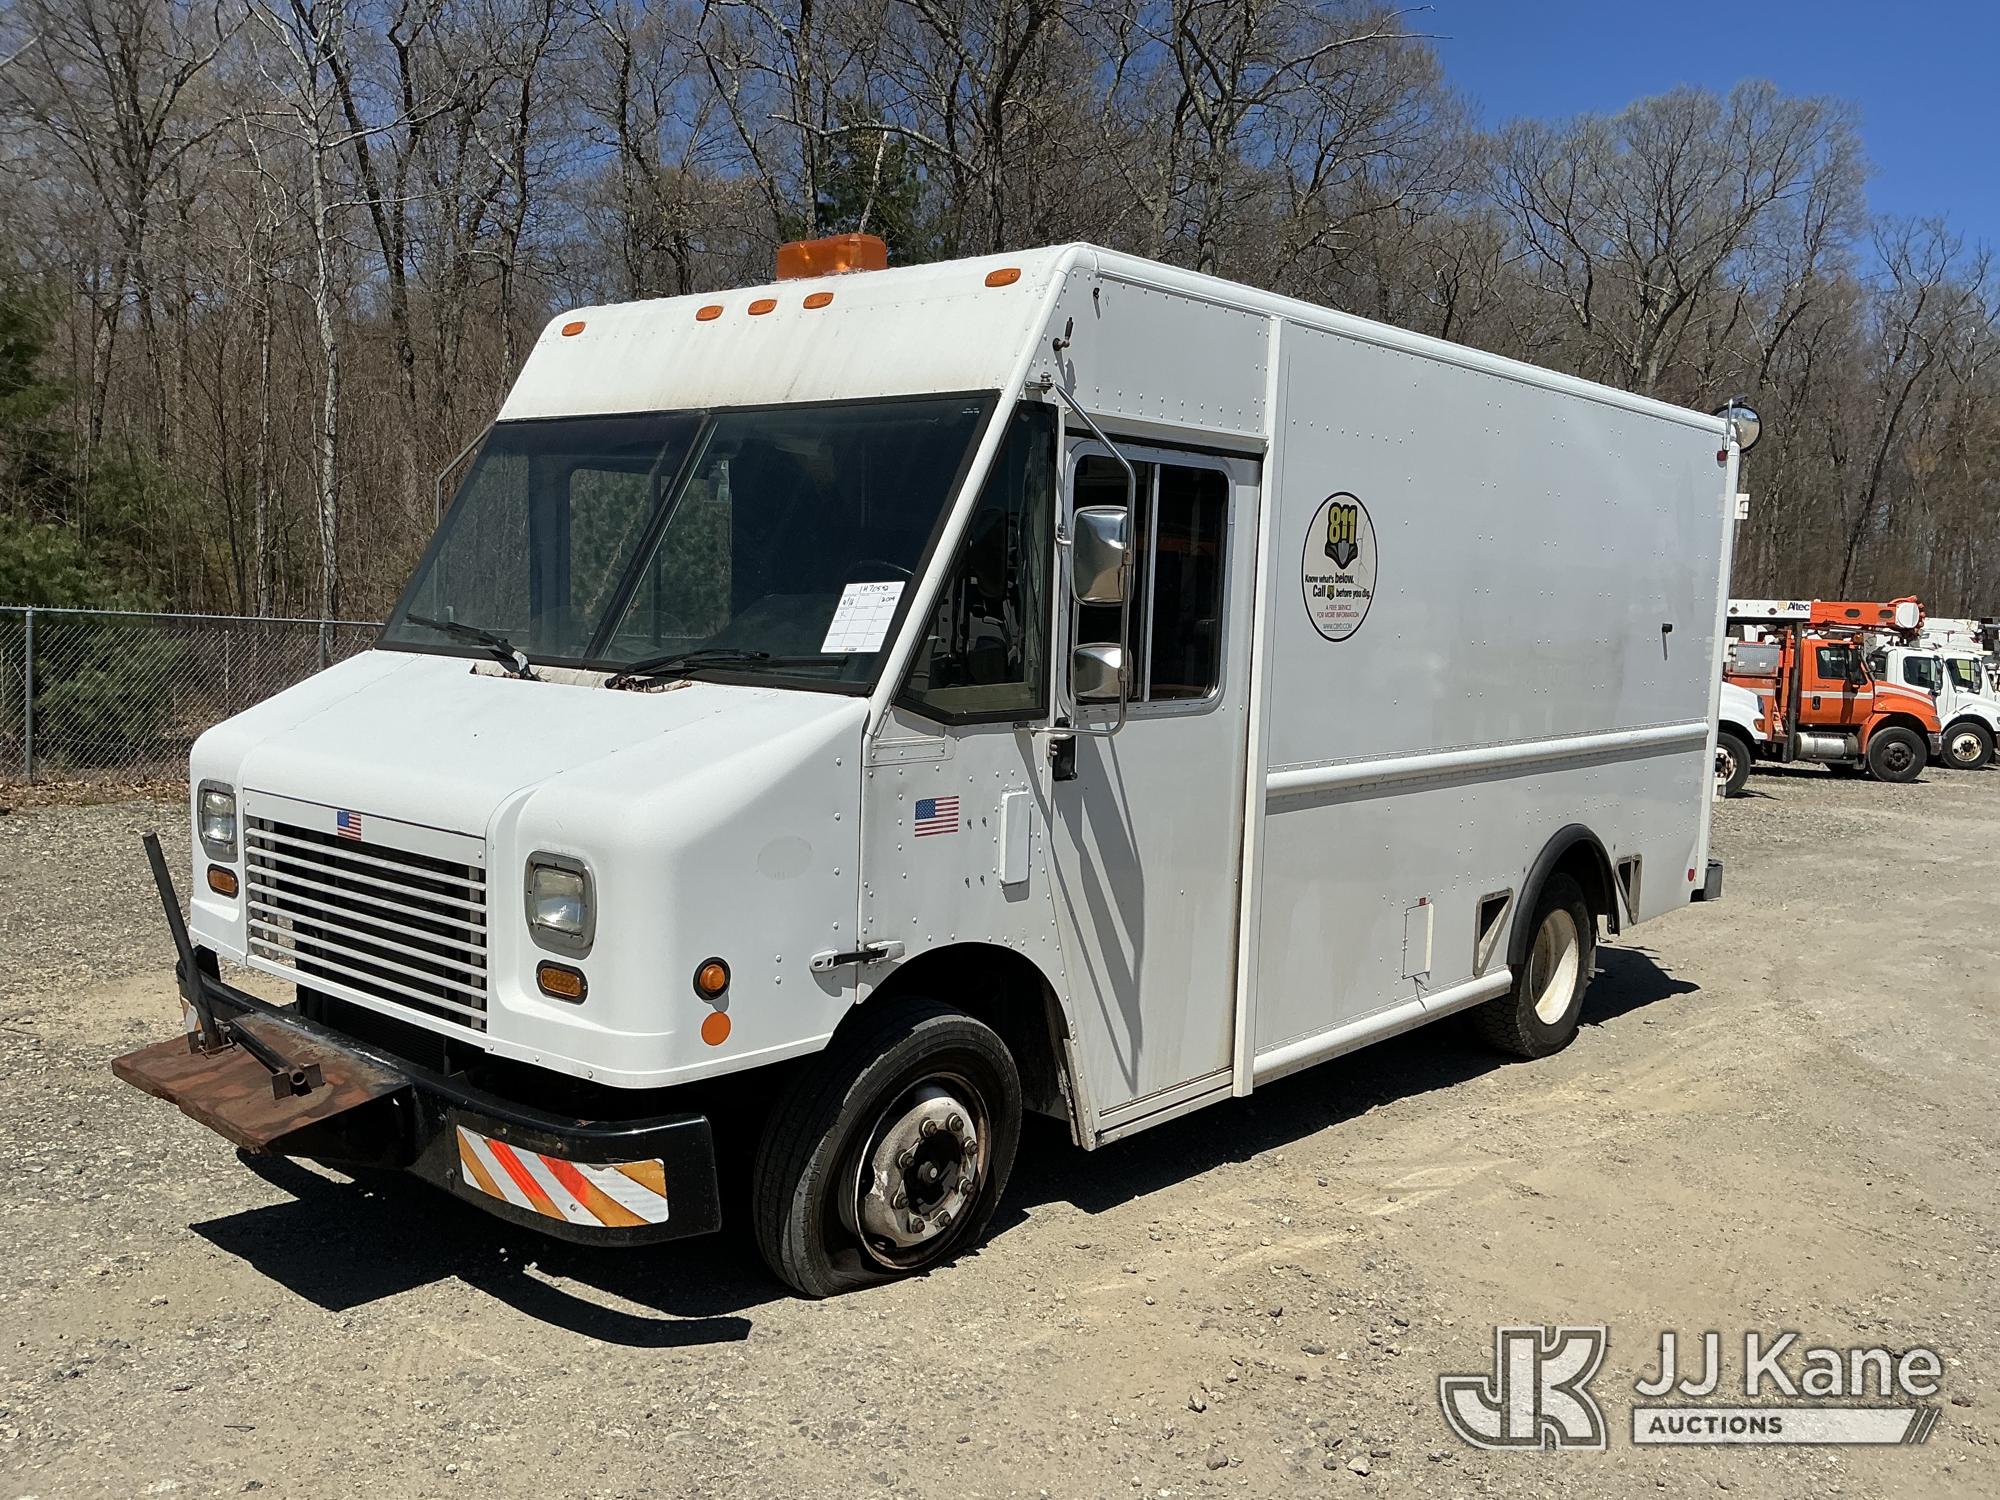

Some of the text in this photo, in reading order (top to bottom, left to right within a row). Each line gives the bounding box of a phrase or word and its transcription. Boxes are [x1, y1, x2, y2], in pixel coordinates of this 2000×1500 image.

[1328, 503, 1357, 544] 811
[1305, 572, 1354, 584] Know what's below.
[1313, 584, 1326, 597] Call
[1336, 588, 1352, 597] before
[1353, 590, 1361, 599] you
[1362, 589, 1372, 600] dig.
[1787, 601, 1810, 611] Altec
